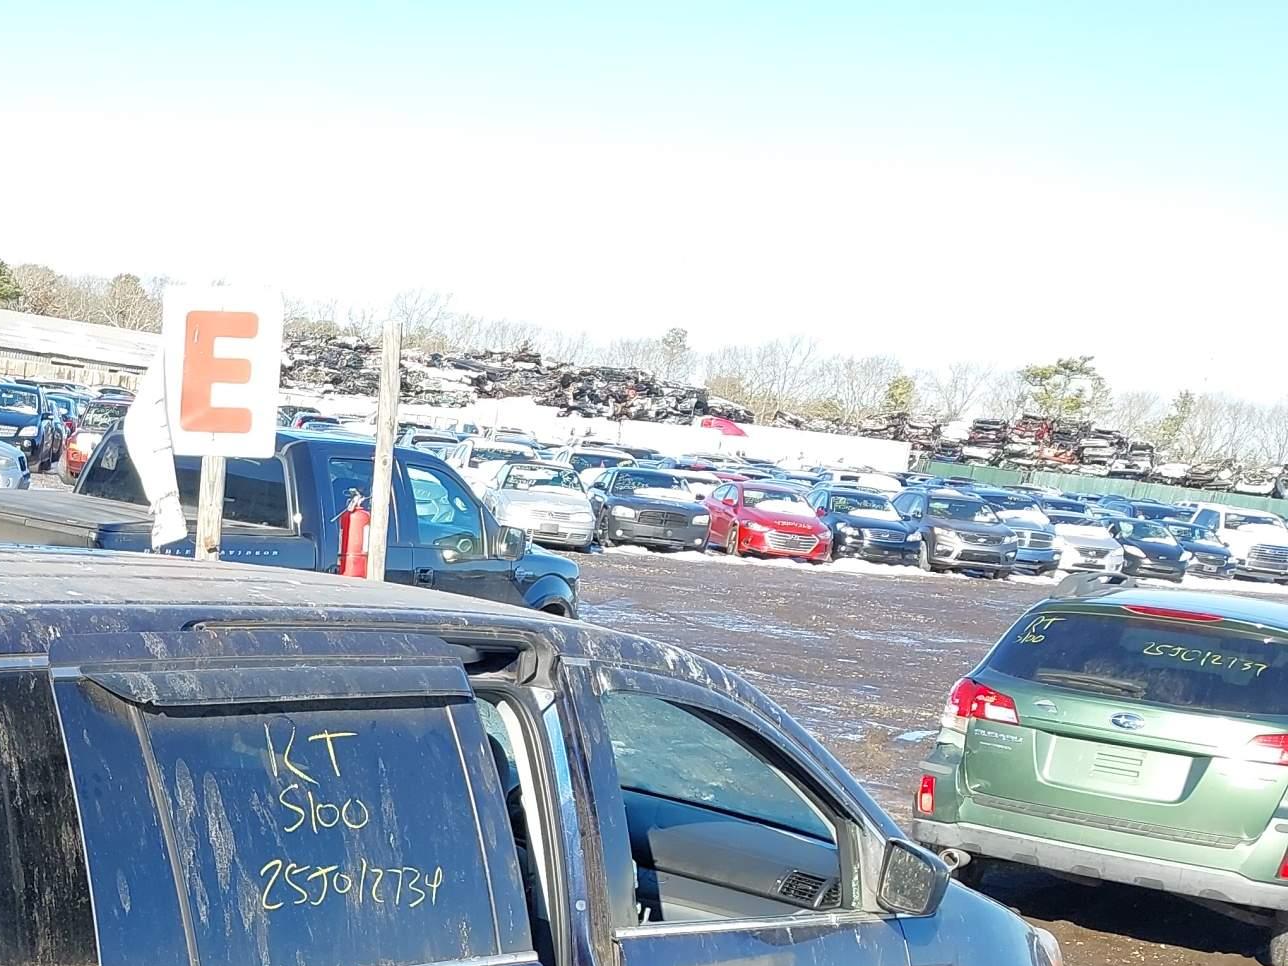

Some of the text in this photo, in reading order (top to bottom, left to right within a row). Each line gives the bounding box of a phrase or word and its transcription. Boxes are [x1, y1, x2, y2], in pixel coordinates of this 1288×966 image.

[180, 310, 259, 434] E
[278, 783, 369, 835] S100
[259, 856, 443, 910] 25J012734
